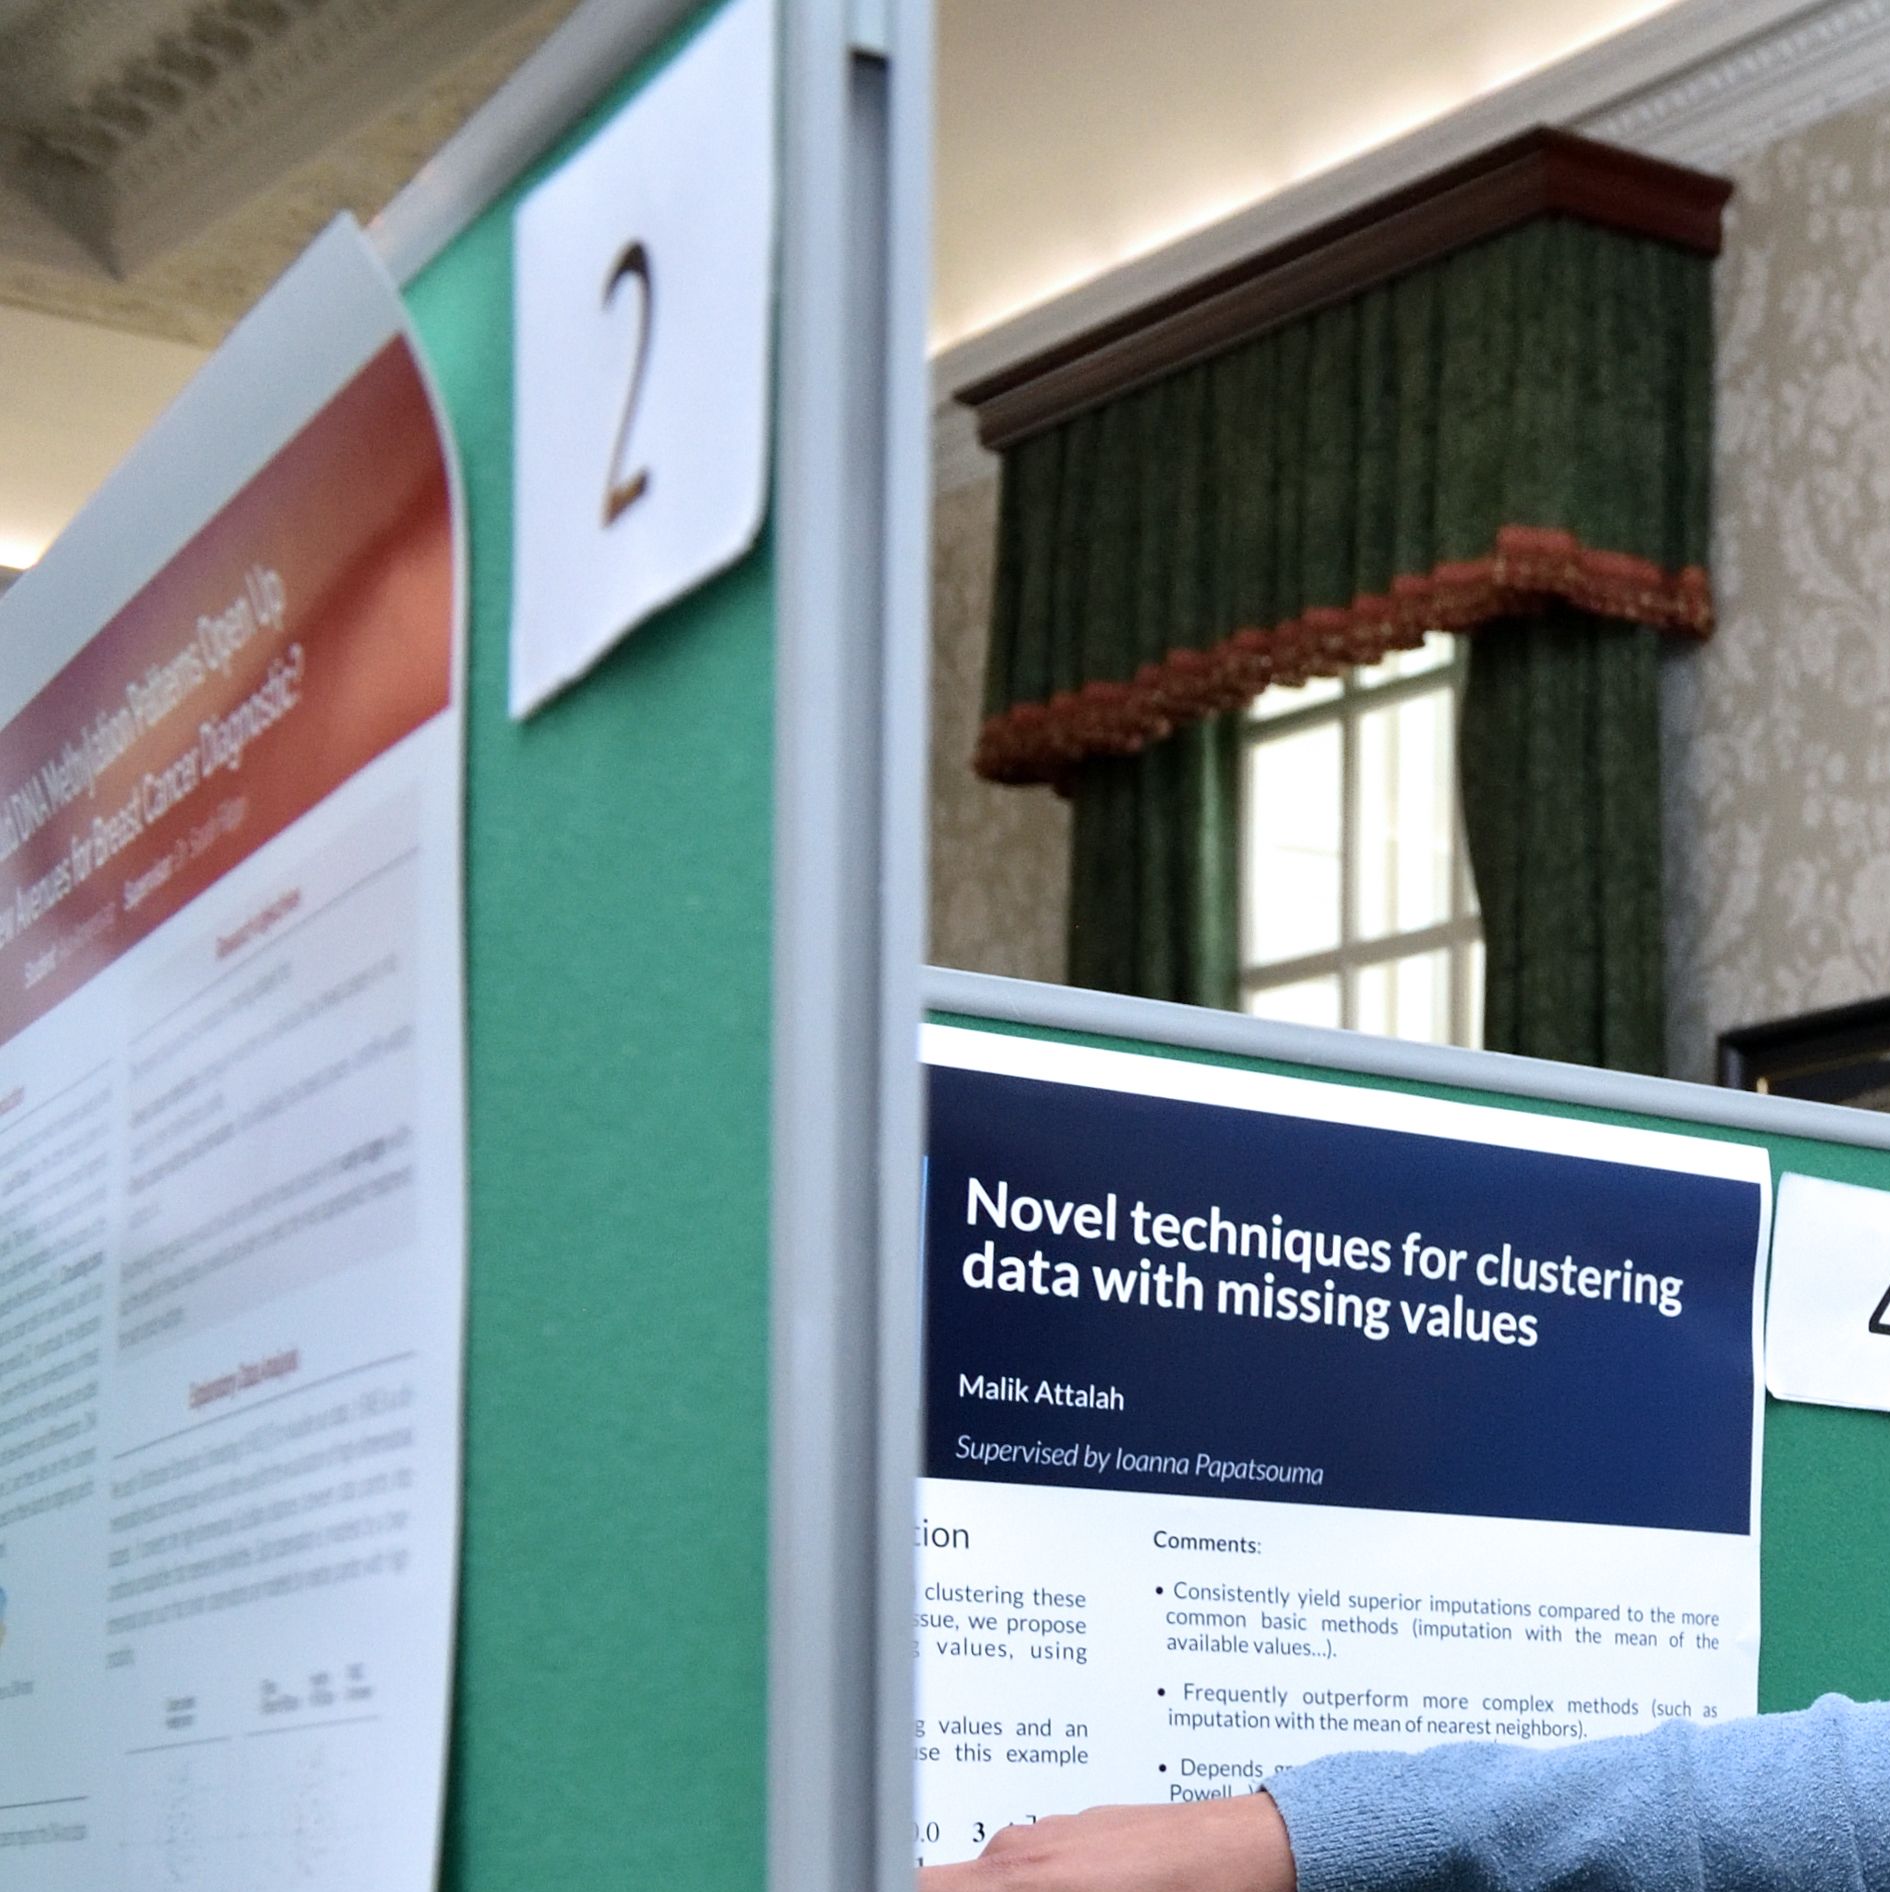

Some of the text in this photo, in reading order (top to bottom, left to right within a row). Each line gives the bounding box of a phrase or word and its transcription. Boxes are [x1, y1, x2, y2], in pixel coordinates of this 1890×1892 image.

[600, 239, 654, 527] 2
[966, 1176, 1684, 1318] Novel techniques for clustering
[962, 1239, 1538, 1347] data with missing values
[959, 1373, 1124, 1411] Malik Attalah
[955, 1434, 1324, 1486] Supervised by Ioanna Papatsouma
[1153, 1530, 1261, 1554] Comments:
[924, 1581, 1086, 1610] clustering these
[1173, 1580, 1720, 1627] Consistently yield superior imputations compared to the more
[967, 1615, 1087, 1637] we propose
[1165, 1611, 1720, 1650] common basic methods (imputation with the mean of the
[936, 1636, 1014, 1660] values,
[1030, 1641, 1088, 1665] using
[1166, 1633, 1337, 1660] available values...).
[1183, 1682, 1718, 1718] Frequently outperform more complex methods (such as
[938, 1715, 1003, 1736] values
[1016, 1717, 1052, 1737] and
[1065, 1723, 1088, 1738] an
[1168, 1708, 1588, 1740] imputation with the mean of nearest neighbors).
[955, 1742, 1089, 1768] this example
